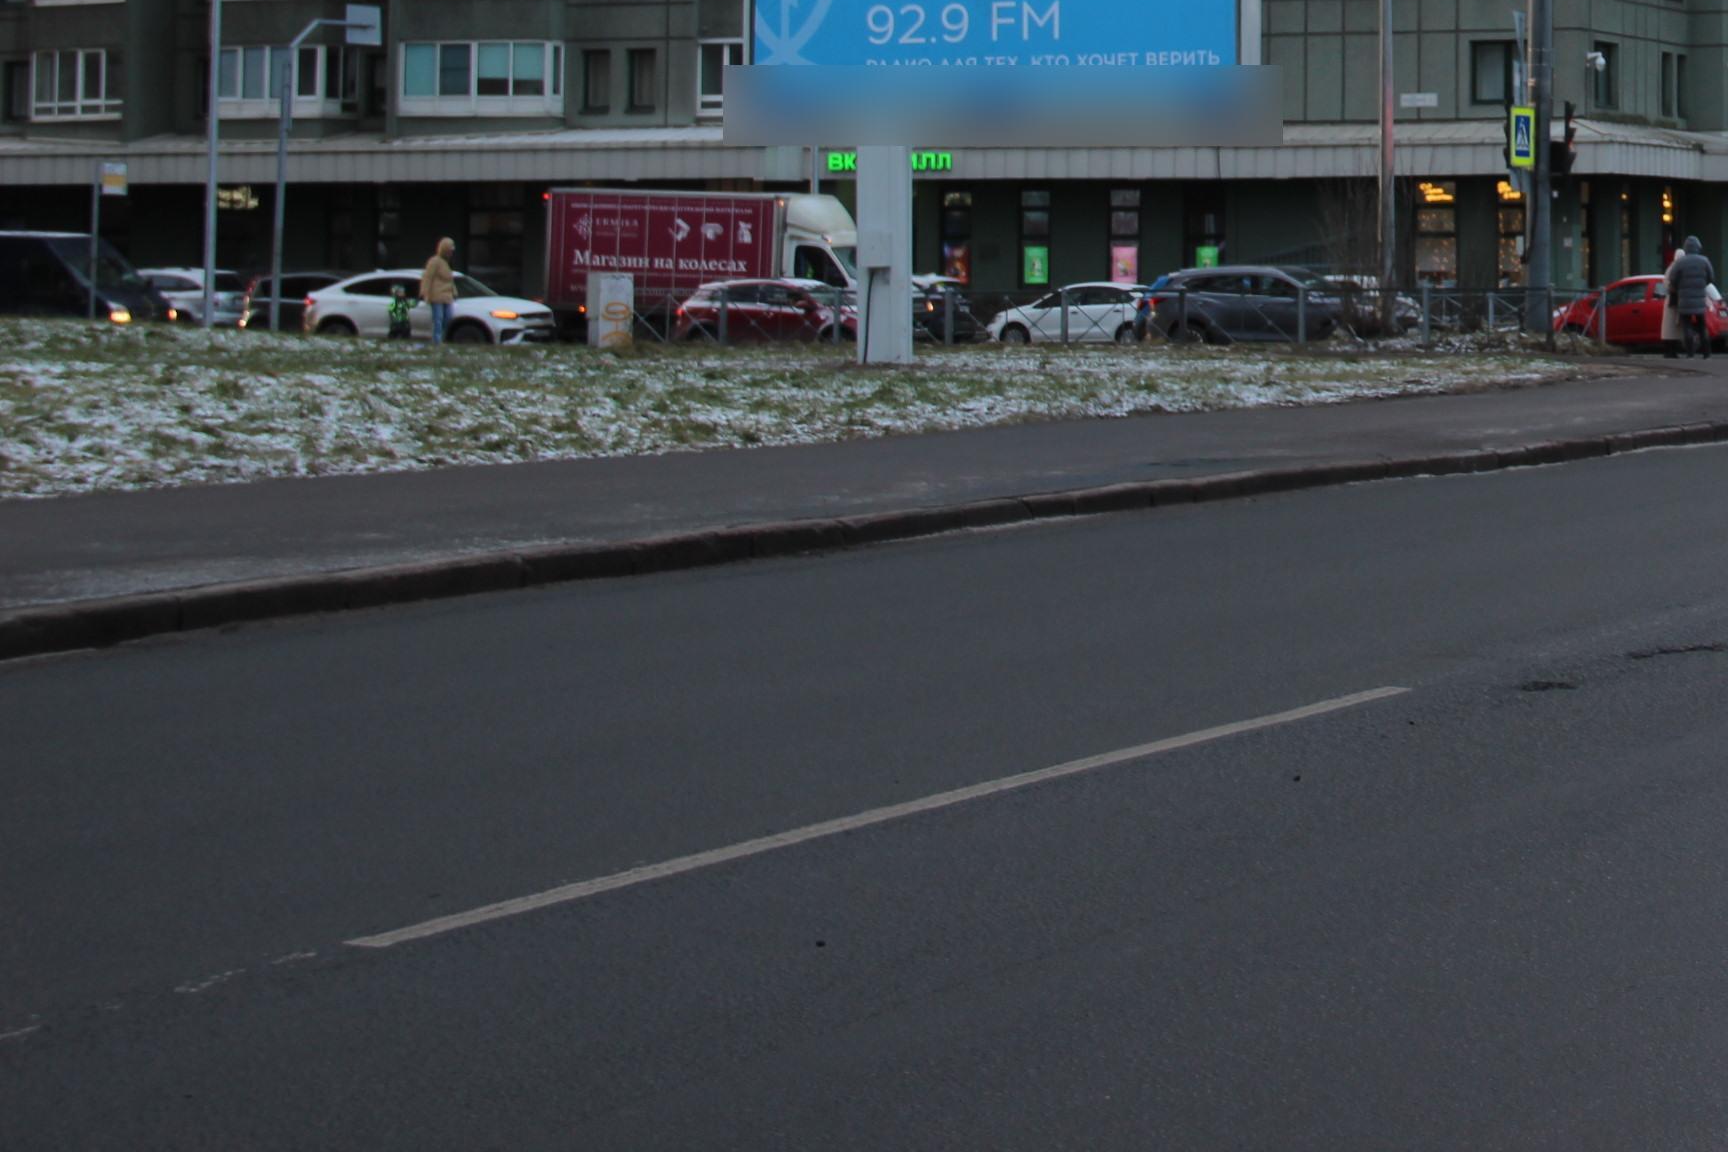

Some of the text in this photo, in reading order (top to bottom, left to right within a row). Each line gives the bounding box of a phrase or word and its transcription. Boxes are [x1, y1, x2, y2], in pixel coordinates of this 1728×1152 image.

[866, 0, 1060, 45] 92.9 FM
[1145, 49, 1220, 65] ВЕРИТЬ
[573, 249, 748, 273] Магазин на колесах
